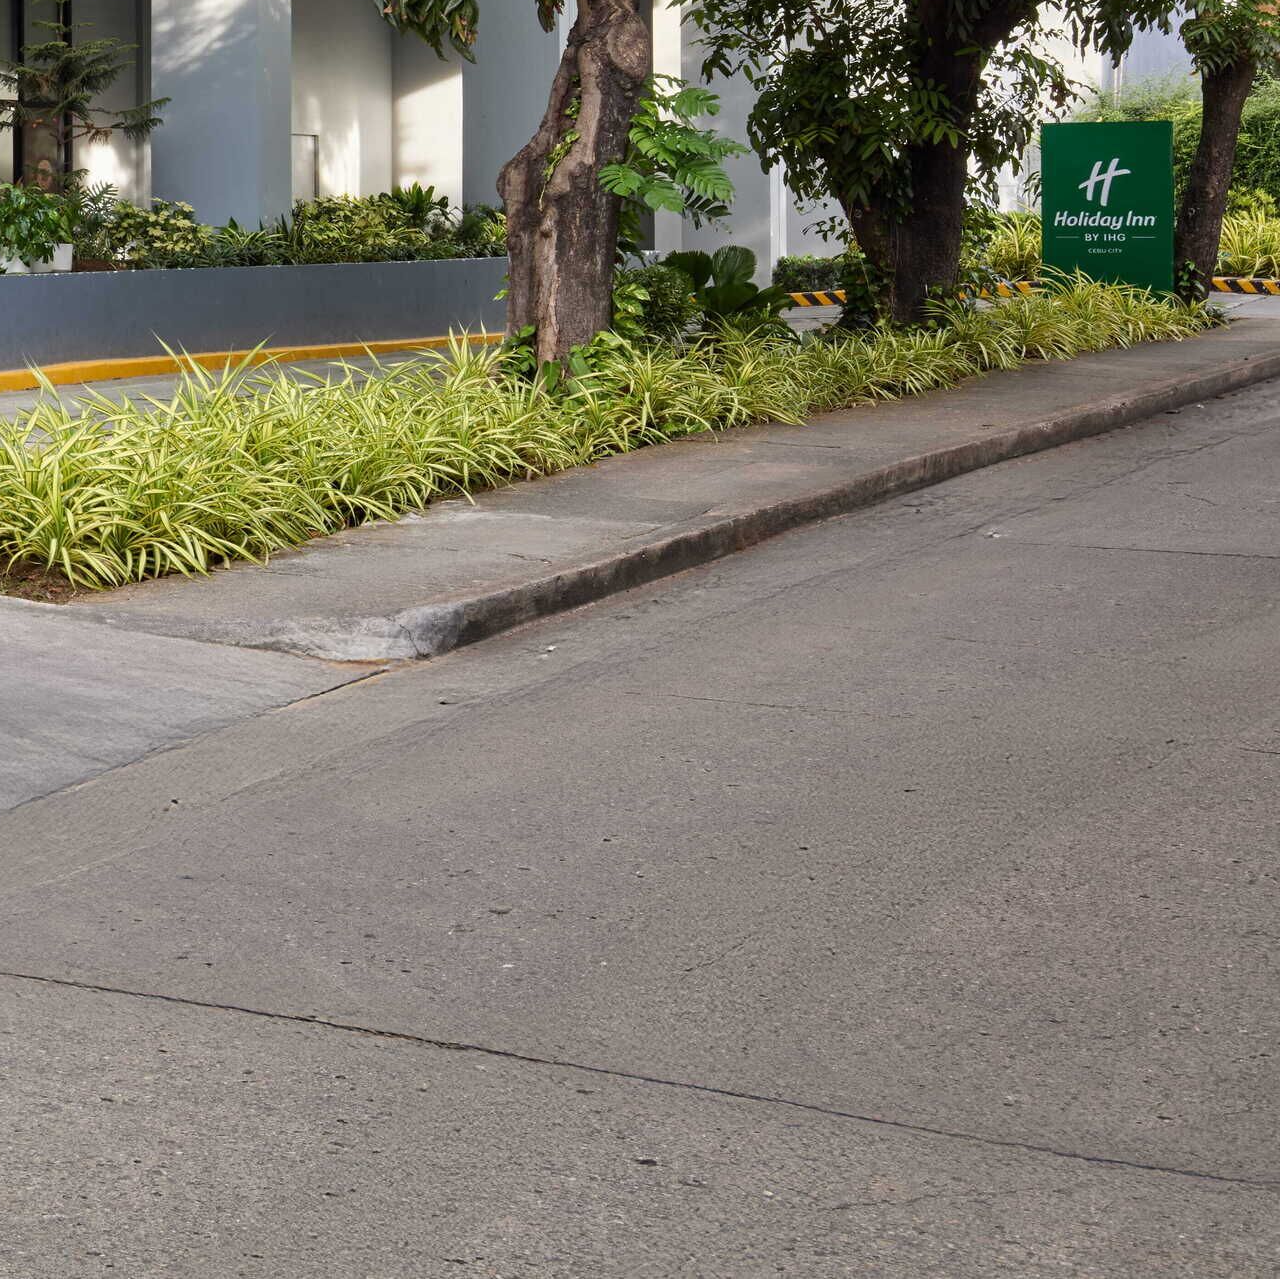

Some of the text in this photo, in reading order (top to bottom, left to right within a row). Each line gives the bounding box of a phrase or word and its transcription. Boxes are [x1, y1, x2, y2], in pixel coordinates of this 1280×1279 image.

[1054, 210, 1156, 230] Holiday Inn
[1084, 233, 1126, 242] BY IHG
